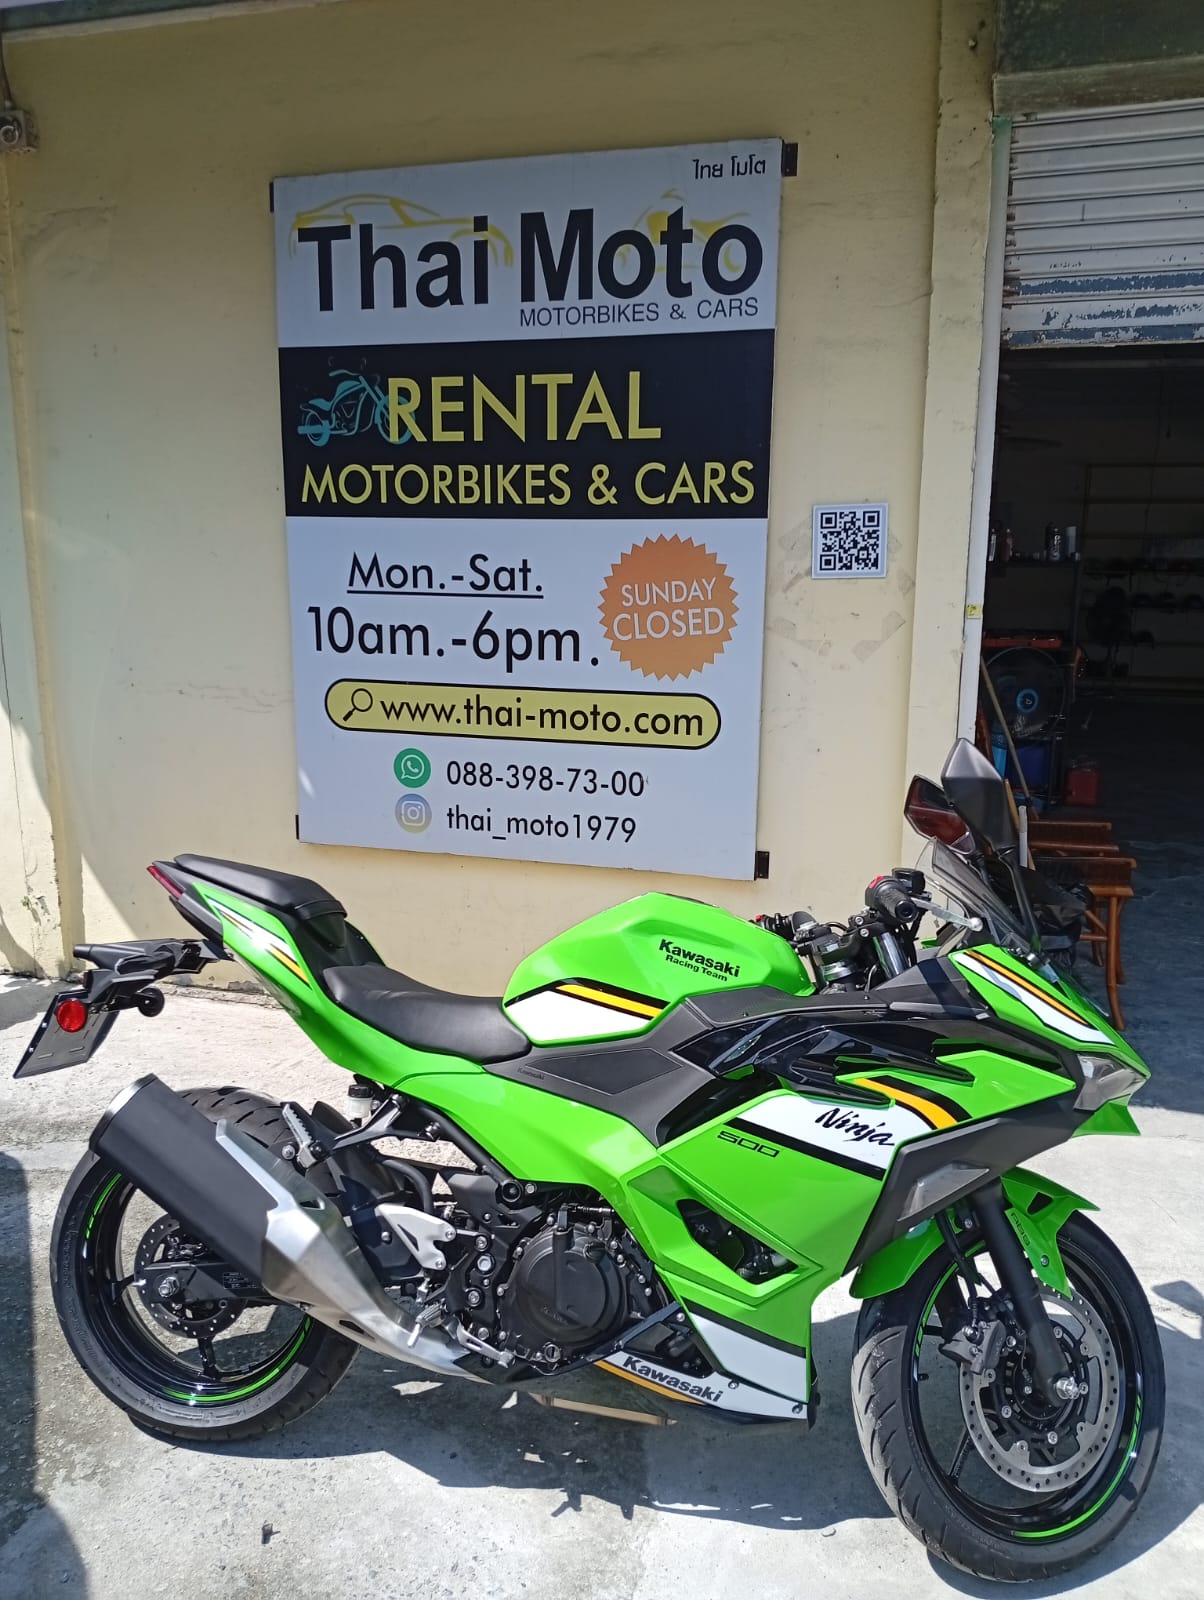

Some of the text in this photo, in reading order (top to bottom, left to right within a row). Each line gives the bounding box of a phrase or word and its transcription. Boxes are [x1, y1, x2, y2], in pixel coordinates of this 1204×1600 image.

[298, 206, 763, 312] Thai Moto
[520, 297, 758, 327] MOTORBIKES & CARS
[387, 370, 662, 443] RENTAL
[301, 460, 755, 506] MOTORBIKES & CARS
[348, 551, 543, 592] Mon.-Sat.
[621, 577, 717, 607] SUNDAY
[613, 607, 724, 641] CLOSED
[380, 694, 703, 736] www.thai-moto.com
[446, 761, 645, 797] 088-398-73-00
[446, 804, 636, 843] thai_moto1979
[659, 939, 741, 978] Kawasaki
[665, 954, 728, 982] Racing Team
[717, 1130, 780, 1158] 500
[814, 1107, 895, 1146] Ninja
[622, 1356, 724, 1402] Kawasaki
